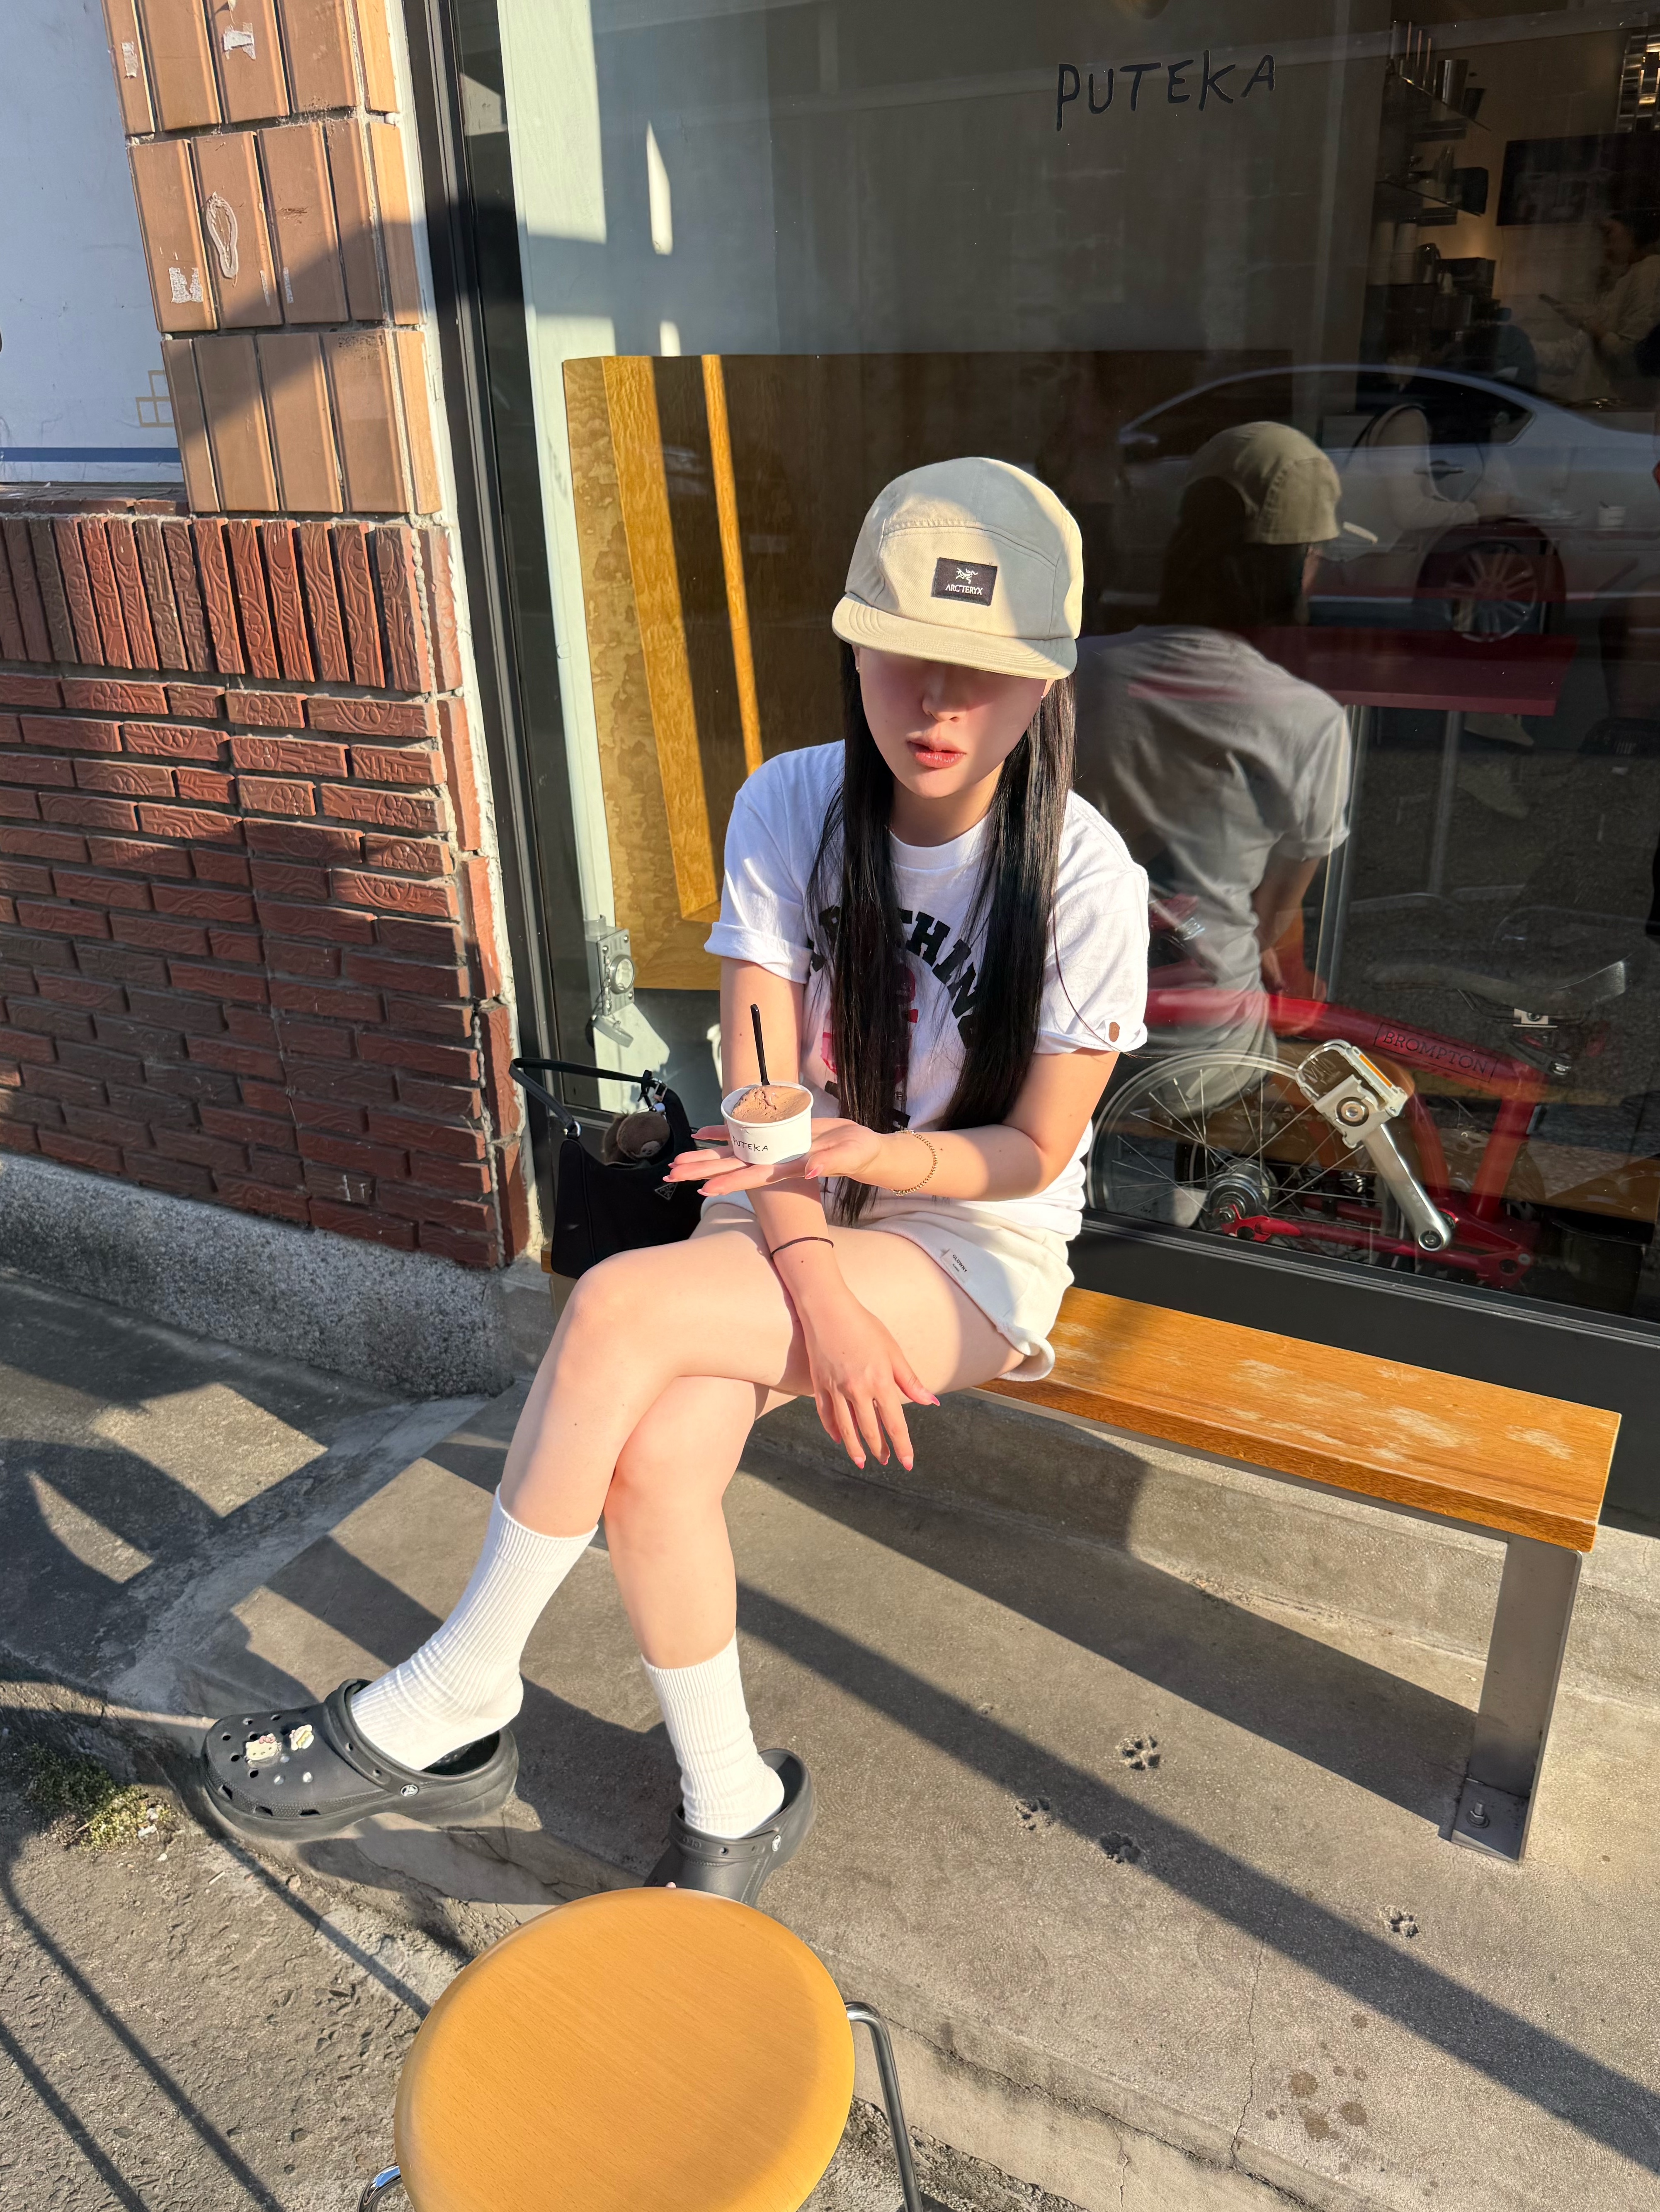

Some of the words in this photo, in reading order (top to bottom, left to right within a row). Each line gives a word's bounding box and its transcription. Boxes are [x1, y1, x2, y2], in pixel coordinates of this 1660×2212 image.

[1056, 49, 1275, 132] PUTEKA
[1383, 1030, 1488, 1074] BROMPTON
[732, 1135, 768, 1152] PUTEKA
